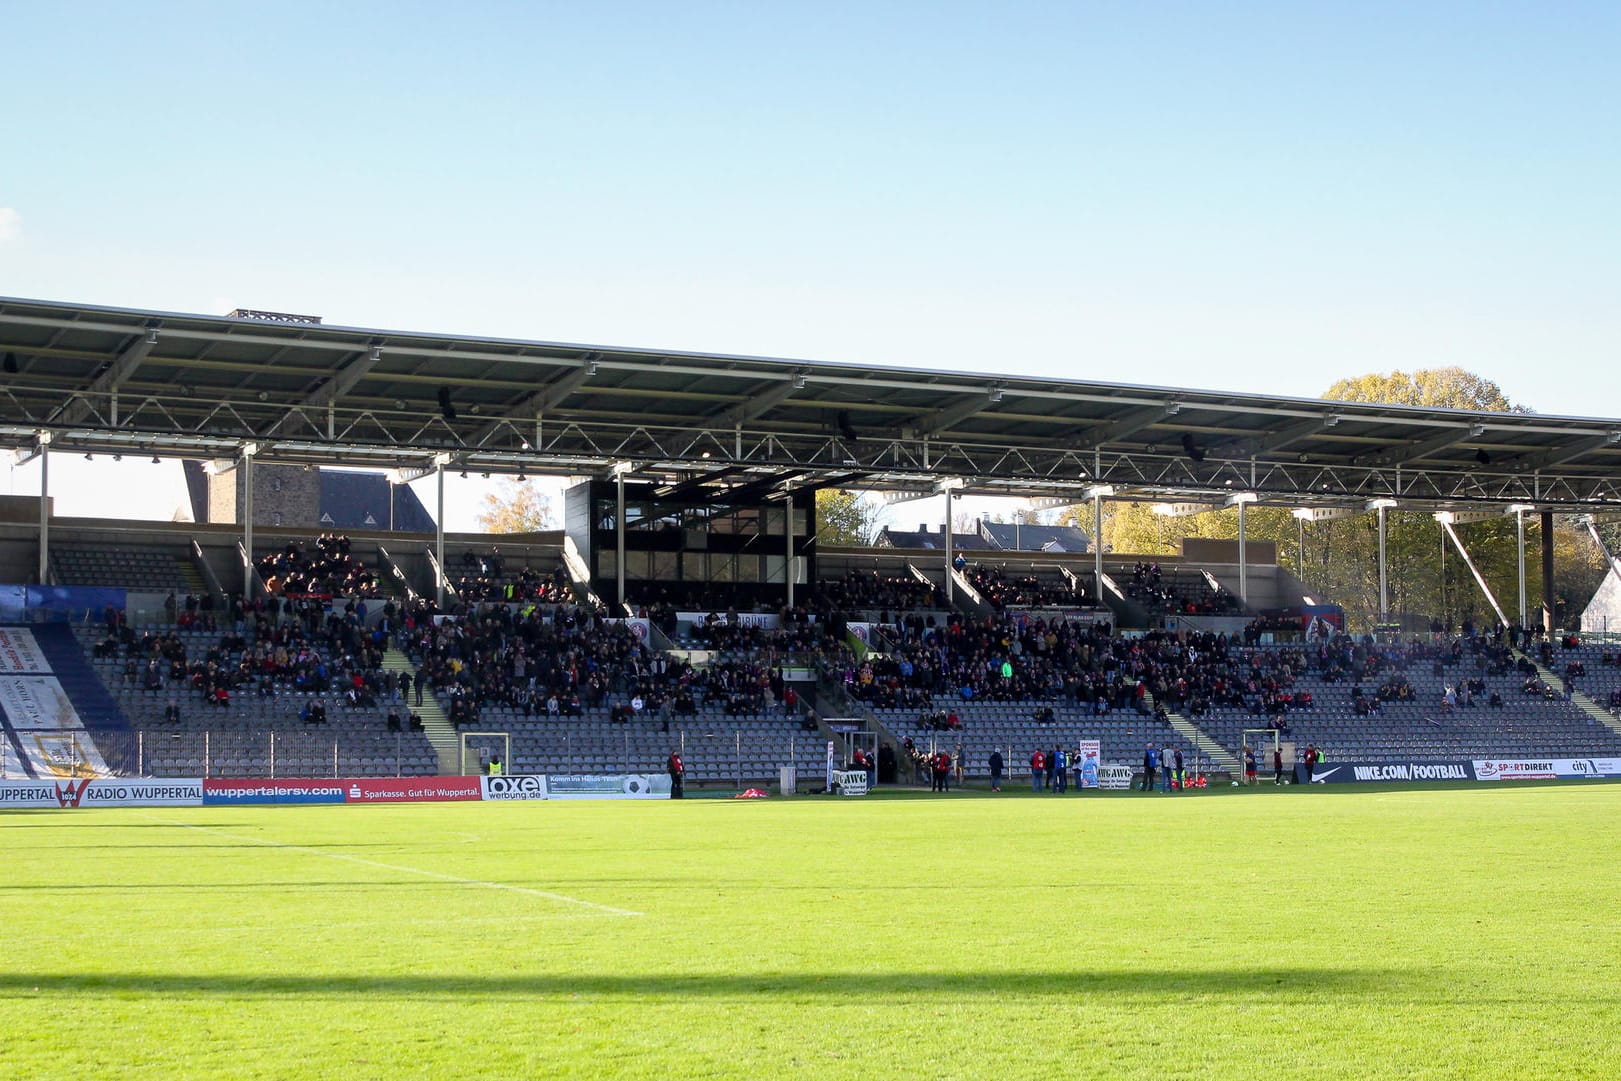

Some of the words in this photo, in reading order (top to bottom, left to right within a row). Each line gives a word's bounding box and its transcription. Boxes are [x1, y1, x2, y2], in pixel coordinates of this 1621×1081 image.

[1354, 763, 1467, 780] NIKE.COM/FOOTBALL
[488, 777, 540, 792] oxe
[88, 788, 127, 800] RADIO
[132, 787, 202, 800] WUPPERTAL
[207, 786, 342, 798] wuppertalersv.com
[364, 790, 406, 799] Sparkasse.
[408, 789, 423, 798] Gut
[424, 788, 435, 797] für
[437, 787, 480, 798] Wuppertal.
[488, 791, 541, 800] werbung.de
